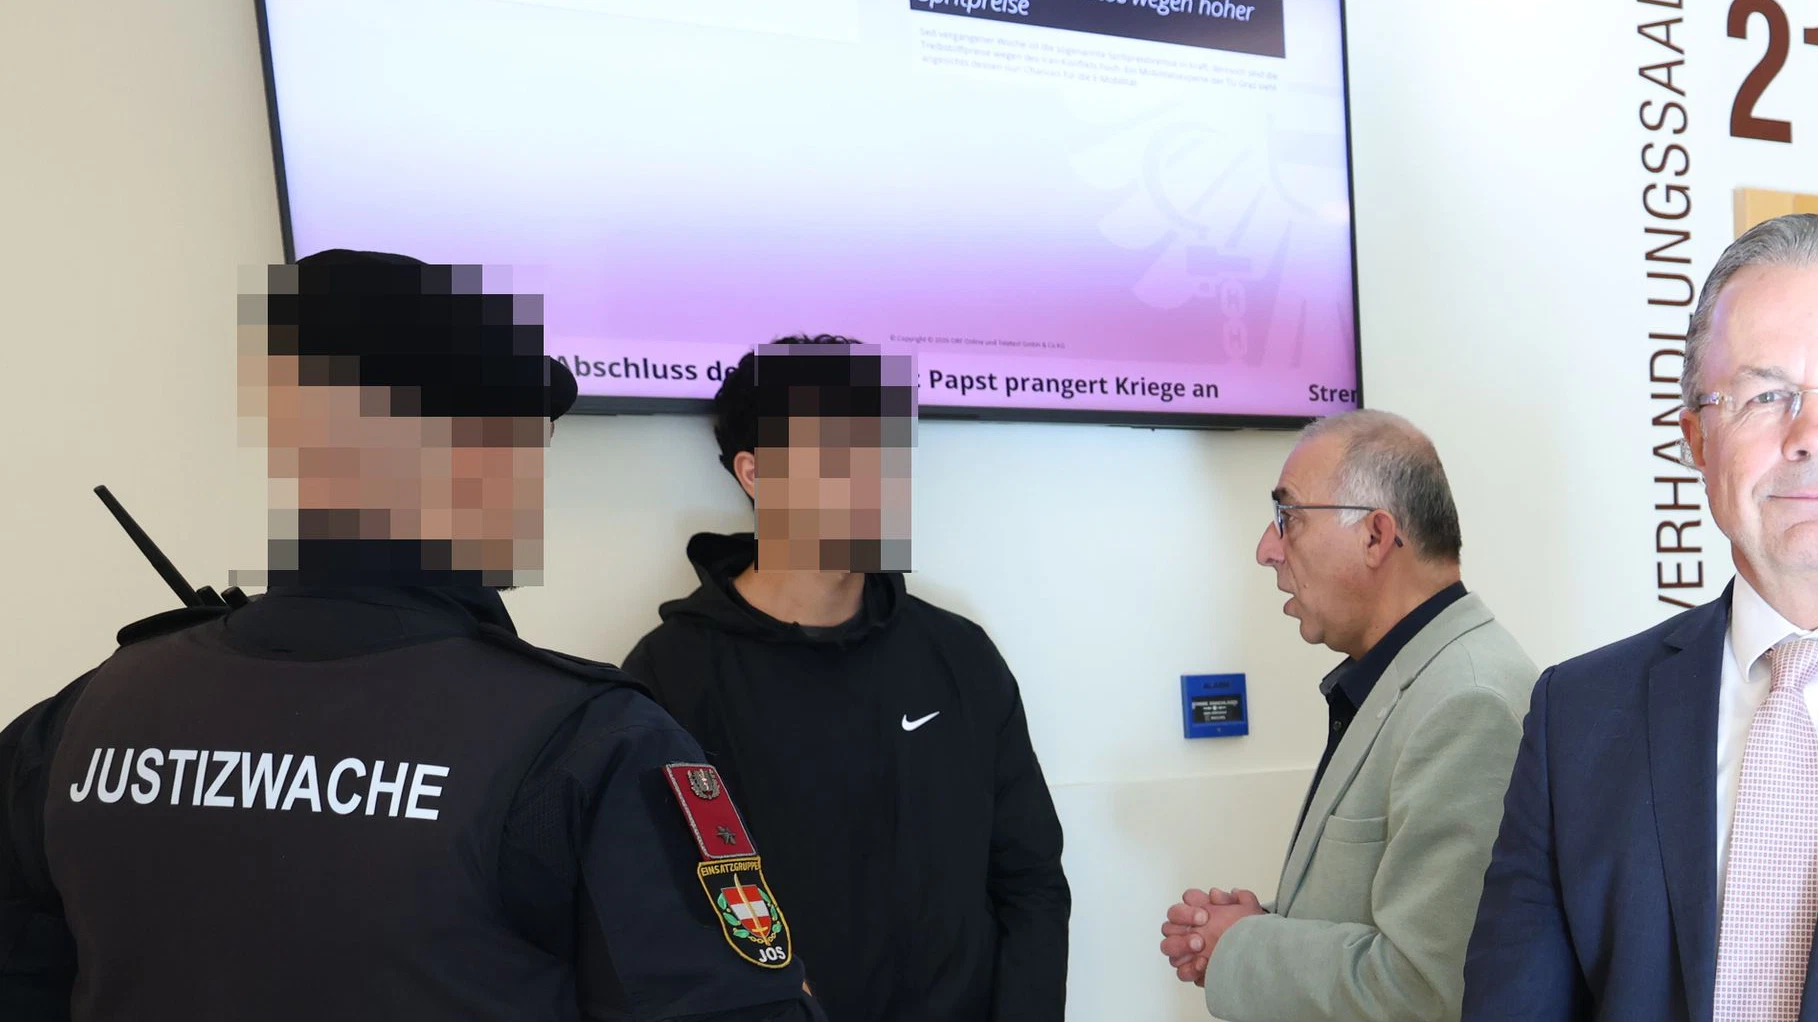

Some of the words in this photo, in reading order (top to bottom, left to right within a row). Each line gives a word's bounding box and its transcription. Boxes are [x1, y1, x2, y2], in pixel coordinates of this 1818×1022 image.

[929, 369, 998, 396] Papst
[1005, 373, 1108, 400] prangert
[1115, 376, 1186, 402] Kriege
[1192, 382, 1219, 398] an
[69, 747, 450, 820] JUSTIZWACHE
[701, 861, 760, 877] EINSATZGRUPPE
[758, 945, 787, 963] JOS
